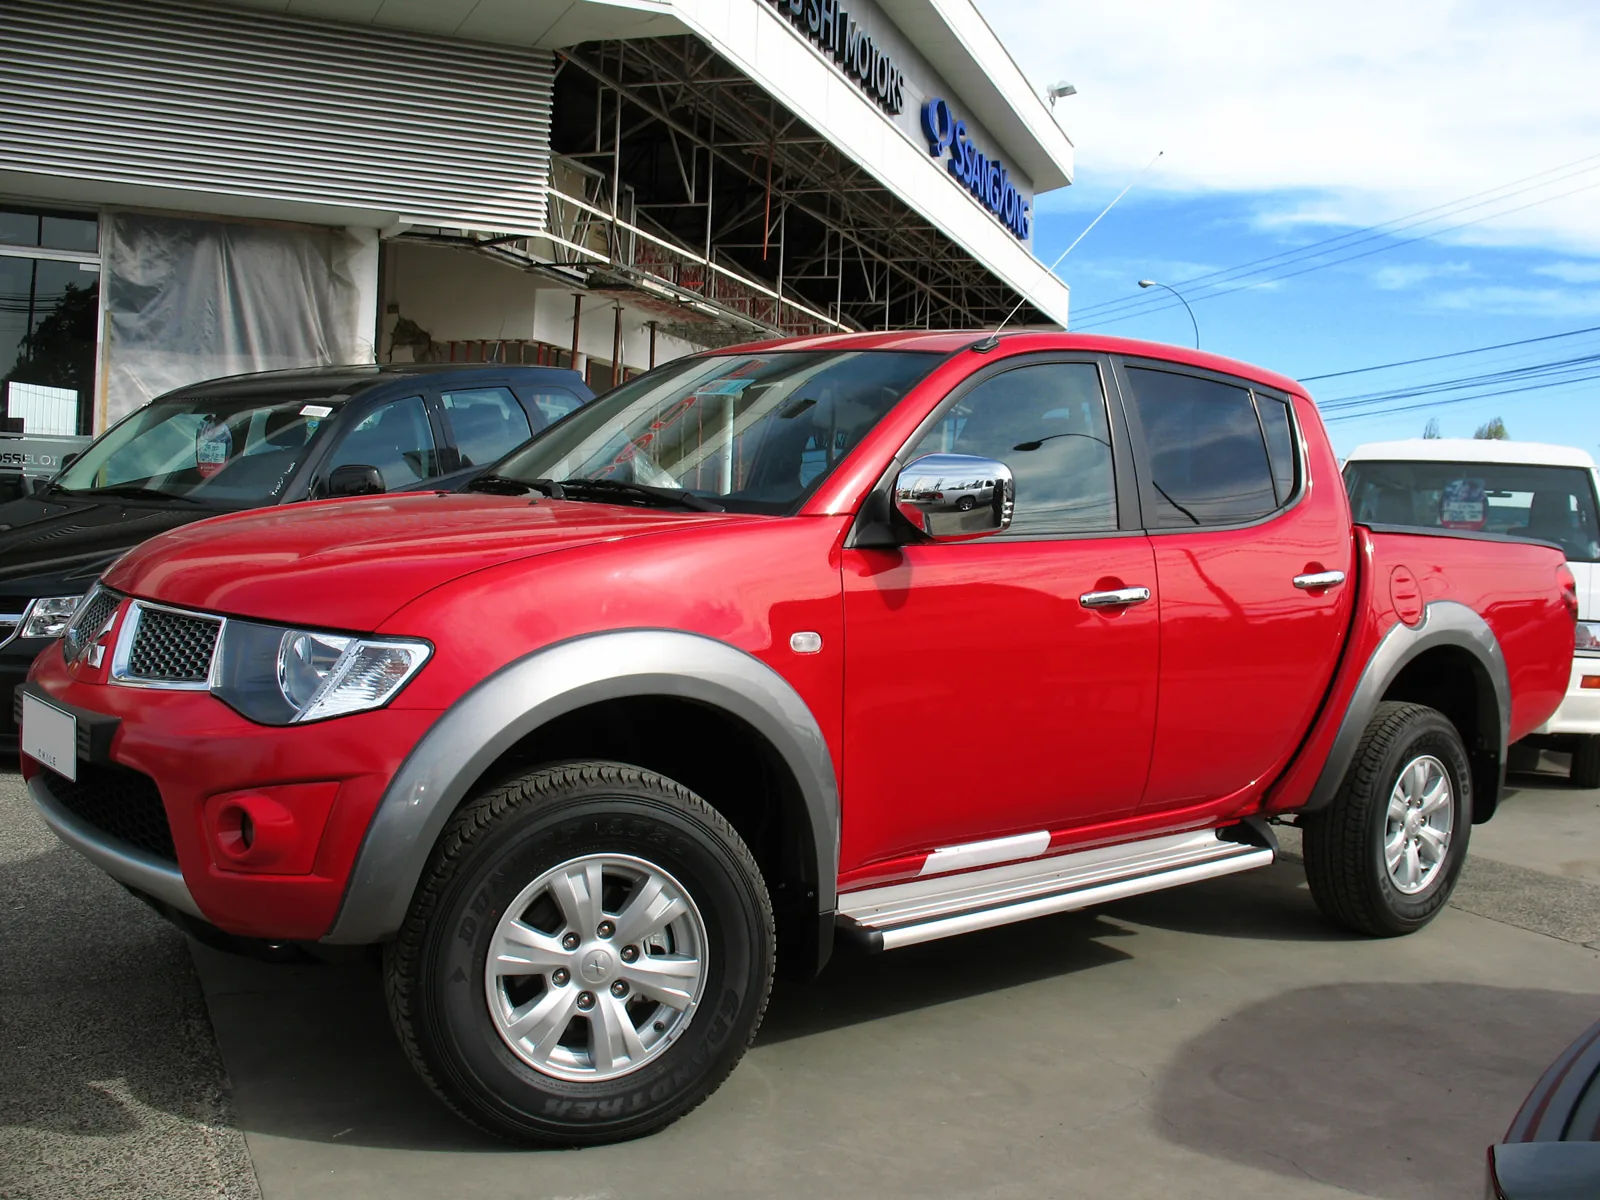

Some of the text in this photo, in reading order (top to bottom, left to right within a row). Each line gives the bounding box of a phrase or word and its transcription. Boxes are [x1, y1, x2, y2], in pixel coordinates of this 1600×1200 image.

[843, 12, 905, 115] MOTORS
[0, 452, 58, 466] SSELOT
[37, 748, 57, 767] CHILE
